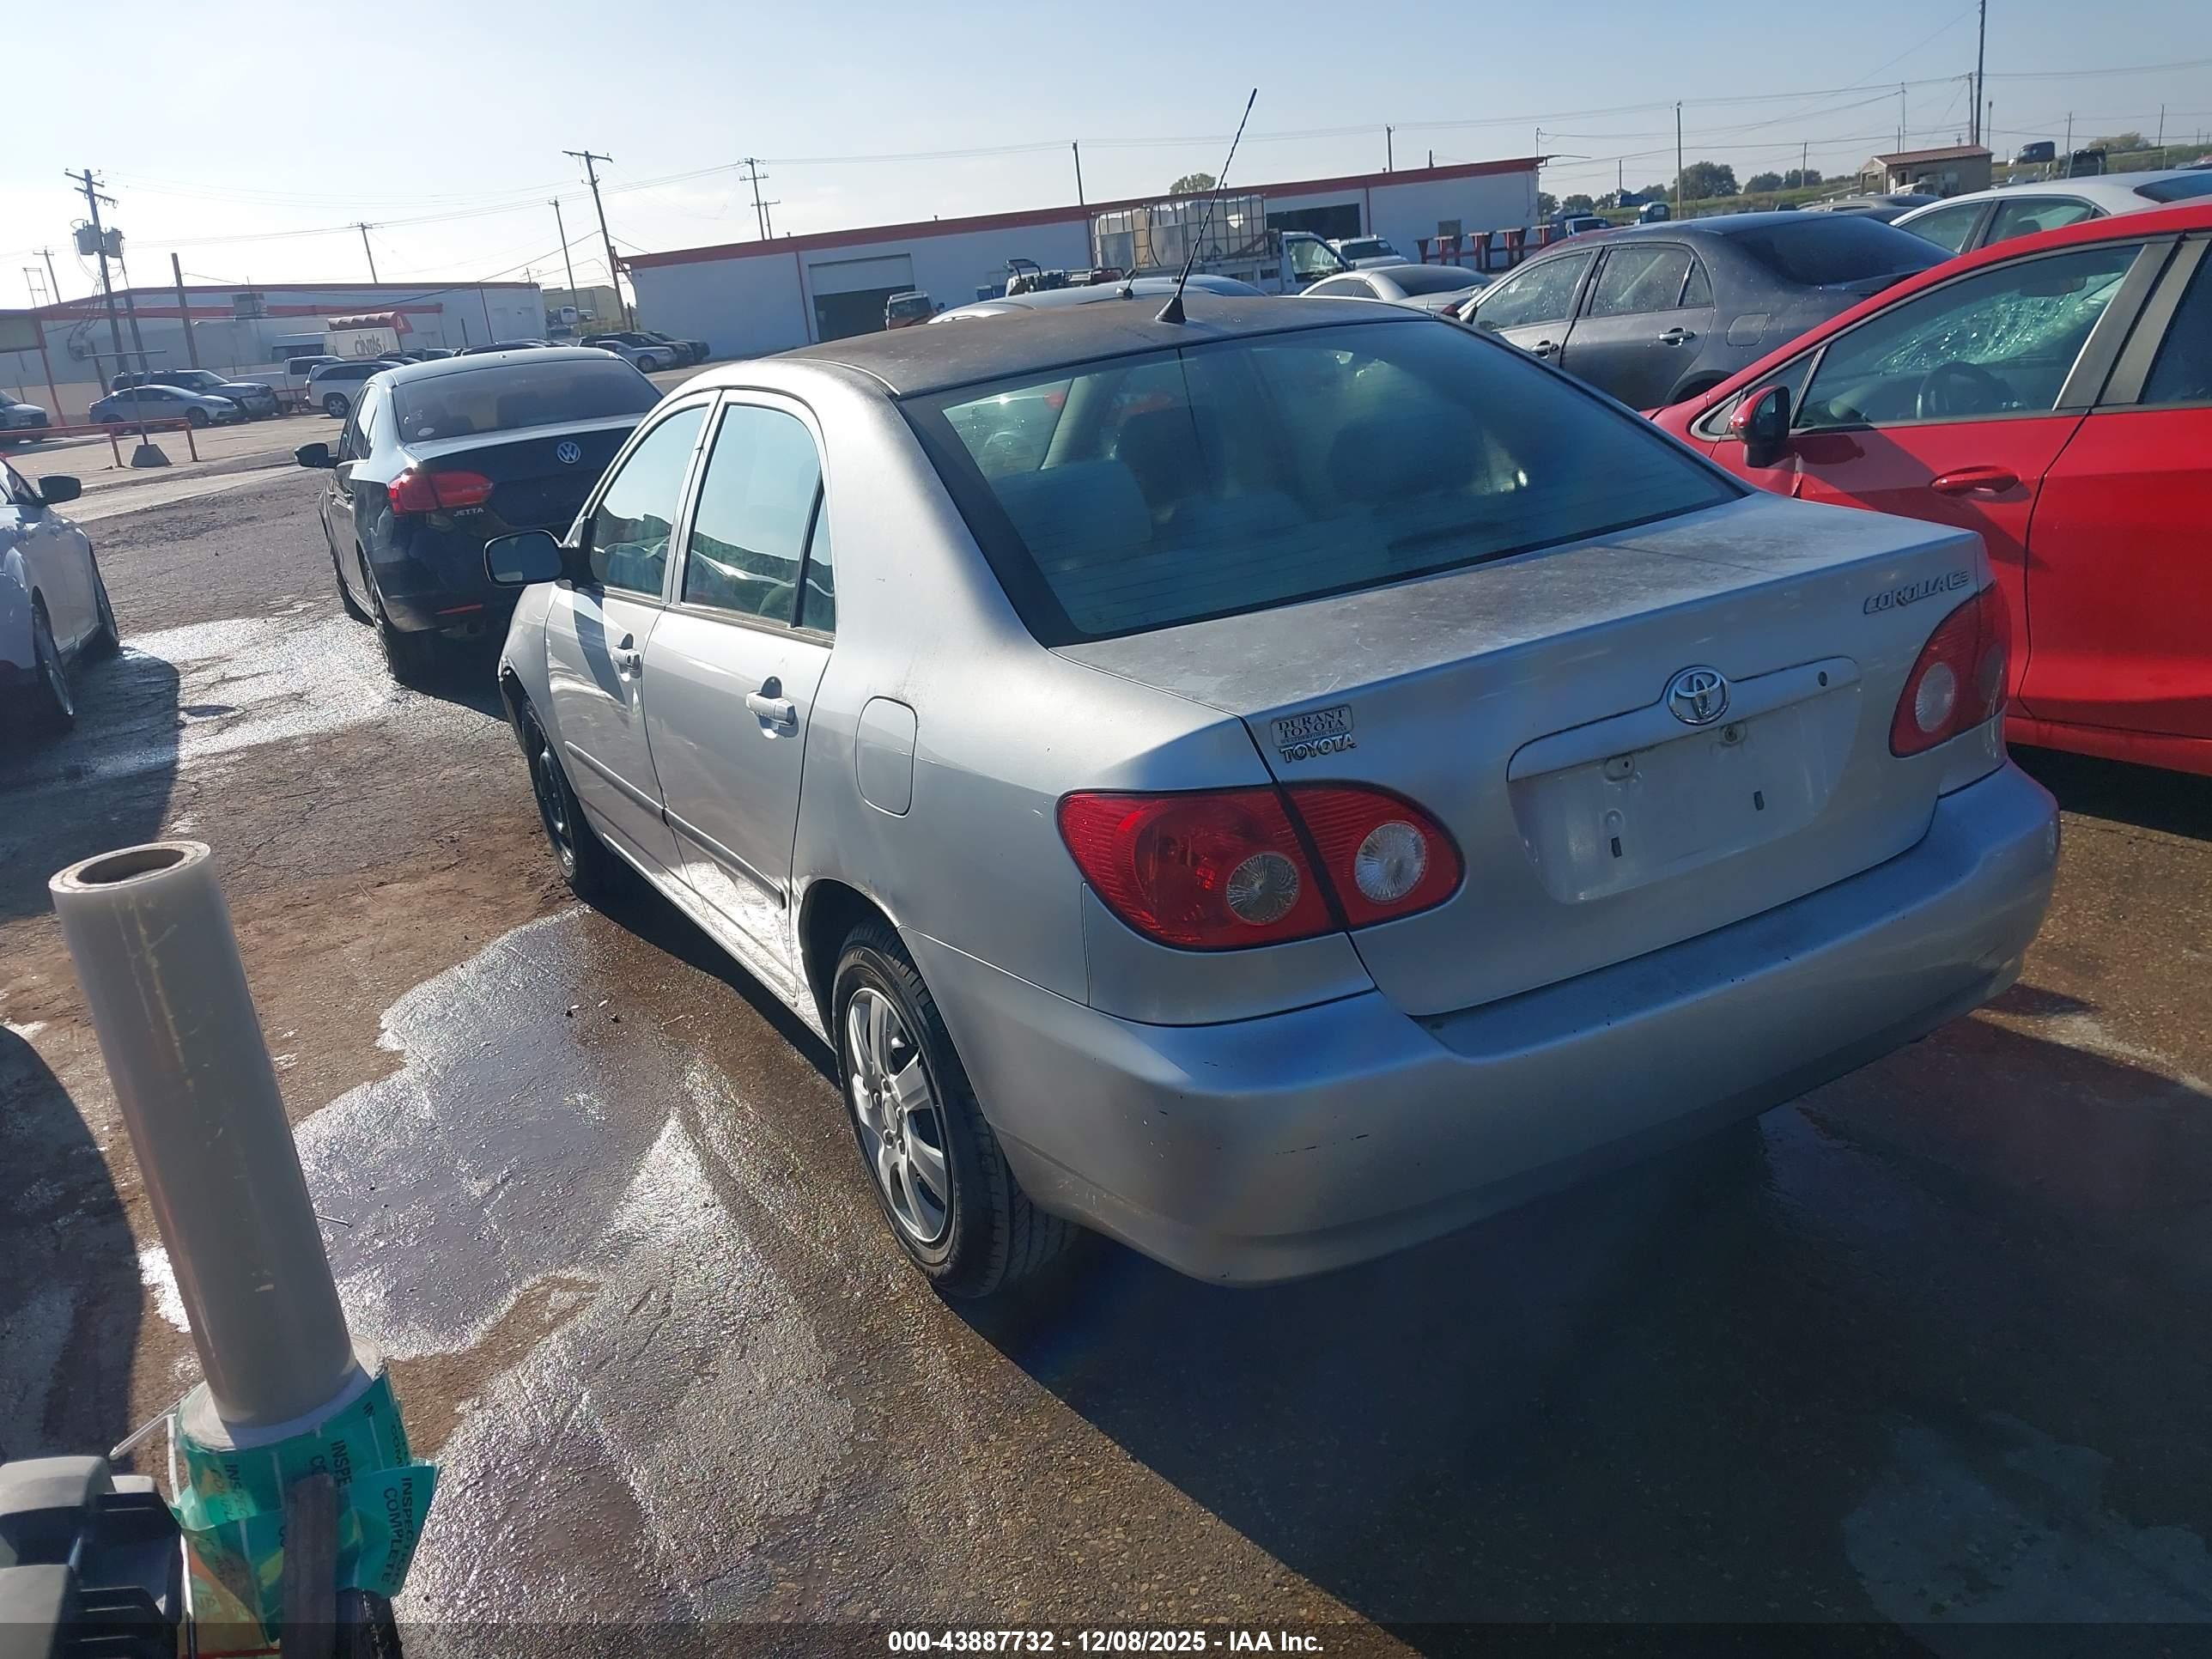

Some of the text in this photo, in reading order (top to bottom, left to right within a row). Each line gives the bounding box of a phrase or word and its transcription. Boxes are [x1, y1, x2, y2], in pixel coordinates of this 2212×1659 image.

[453, 507, 484, 517] JETTA
[1279, 708, 1346, 731] DURANT
[1280, 719, 1345, 738] TOYOTA
[1279, 733, 1357, 763] TOYOTA
[381, 1486, 404, 1583] COMPLETE
